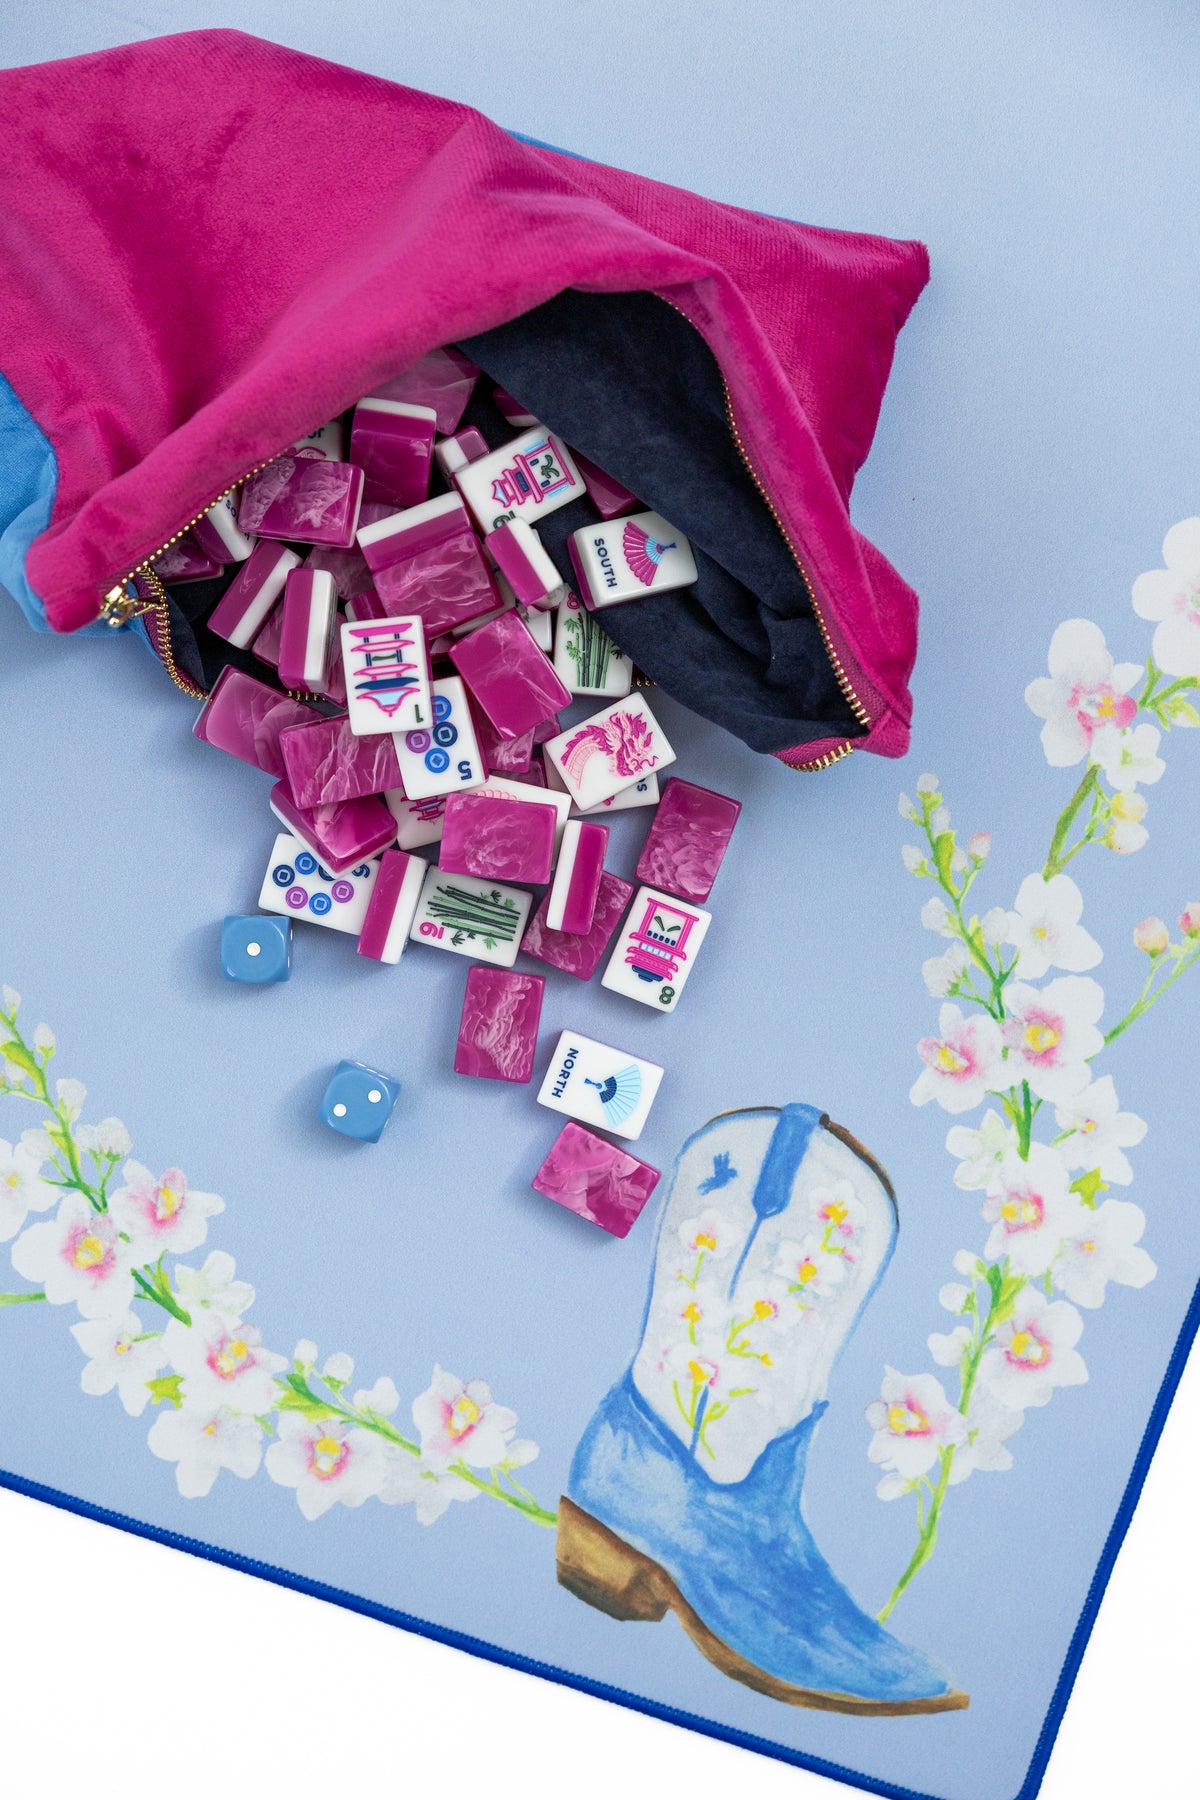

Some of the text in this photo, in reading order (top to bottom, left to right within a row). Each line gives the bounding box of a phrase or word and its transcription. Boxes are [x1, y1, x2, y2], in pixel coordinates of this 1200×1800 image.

[594, 538, 618, 588] SOUTH
[567, 591, 581, 610] 8
[414, 704, 424, 723] 1
[457, 760, 473, 781] 5
[419, 921, 438, 938] 9
[658, 985, 676, 1005] 8
[551, 1047, 579, 1099] NORTH
